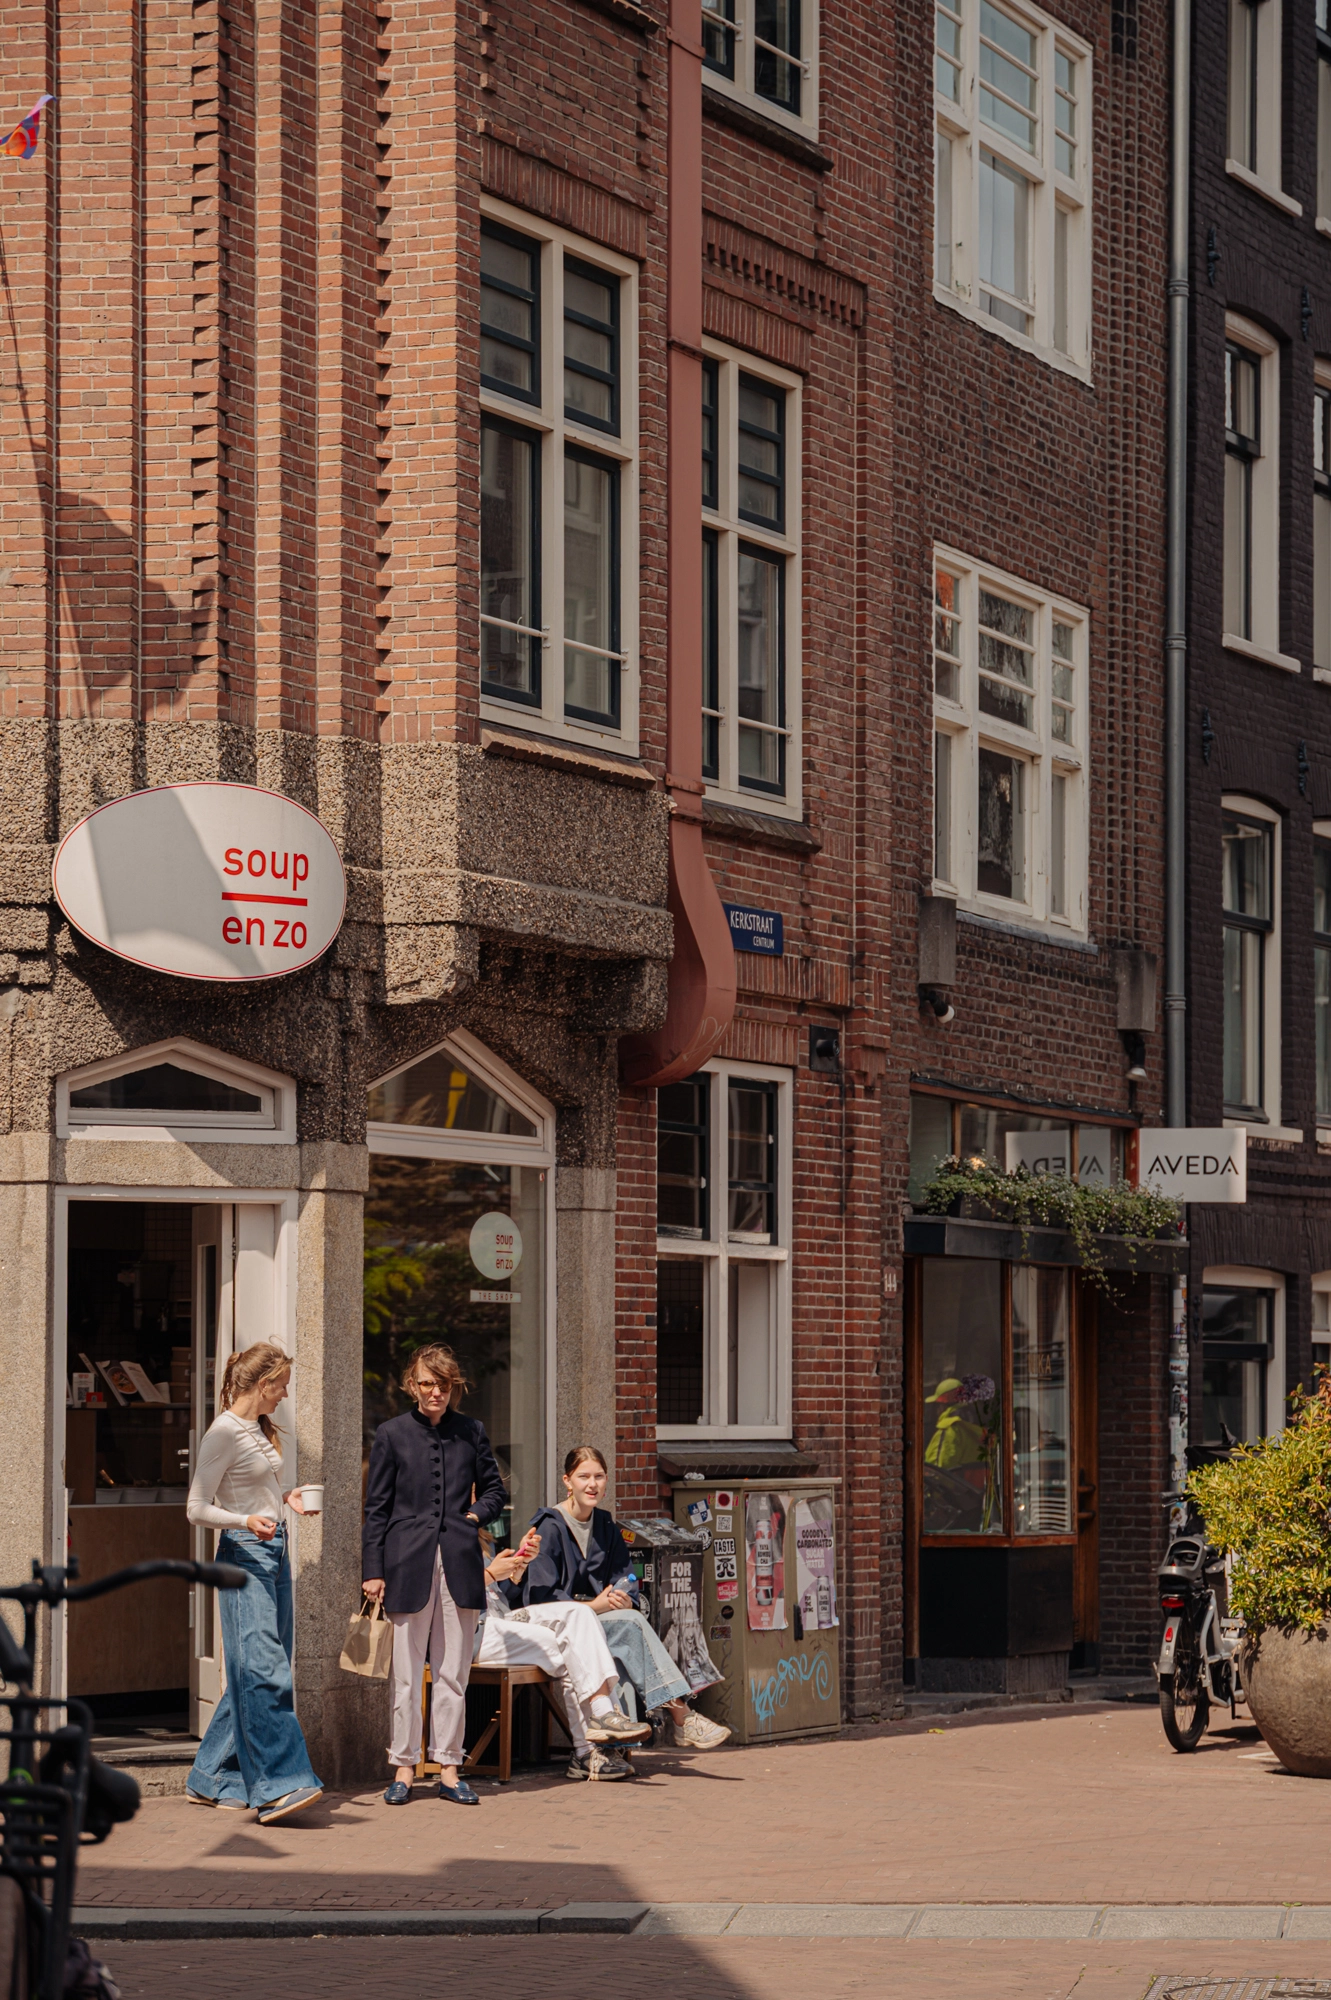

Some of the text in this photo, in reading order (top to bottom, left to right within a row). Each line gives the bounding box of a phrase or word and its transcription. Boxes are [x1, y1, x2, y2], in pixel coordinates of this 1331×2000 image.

[223, 848, 309, 891] soup
[730, 910, 774, 934] KERKSTRAAT
[753, 936, 774, 949] CENTRUM
[1148, 1155, 1239, 1175] AVEDA
[496, 1234, 513, 1249] soup
[884, 1273, 897, 1292] 144
[479, 1292, 513, 1301] THE SHOP
[801, 1529, 827, 1538] GOODBYE
[715, 1540, 735, 1554] TASTE
[797, 1539, 832, 1548] CARBONATED
[805, 1549, 825, 1559] SUGAR
[670, 1561, 692, 1577] FOR
[805, 1559, 825, 1568] WATER
[670, 1577, 692, 1592] THE
[664, 1592, 697, 1608] LIVING
